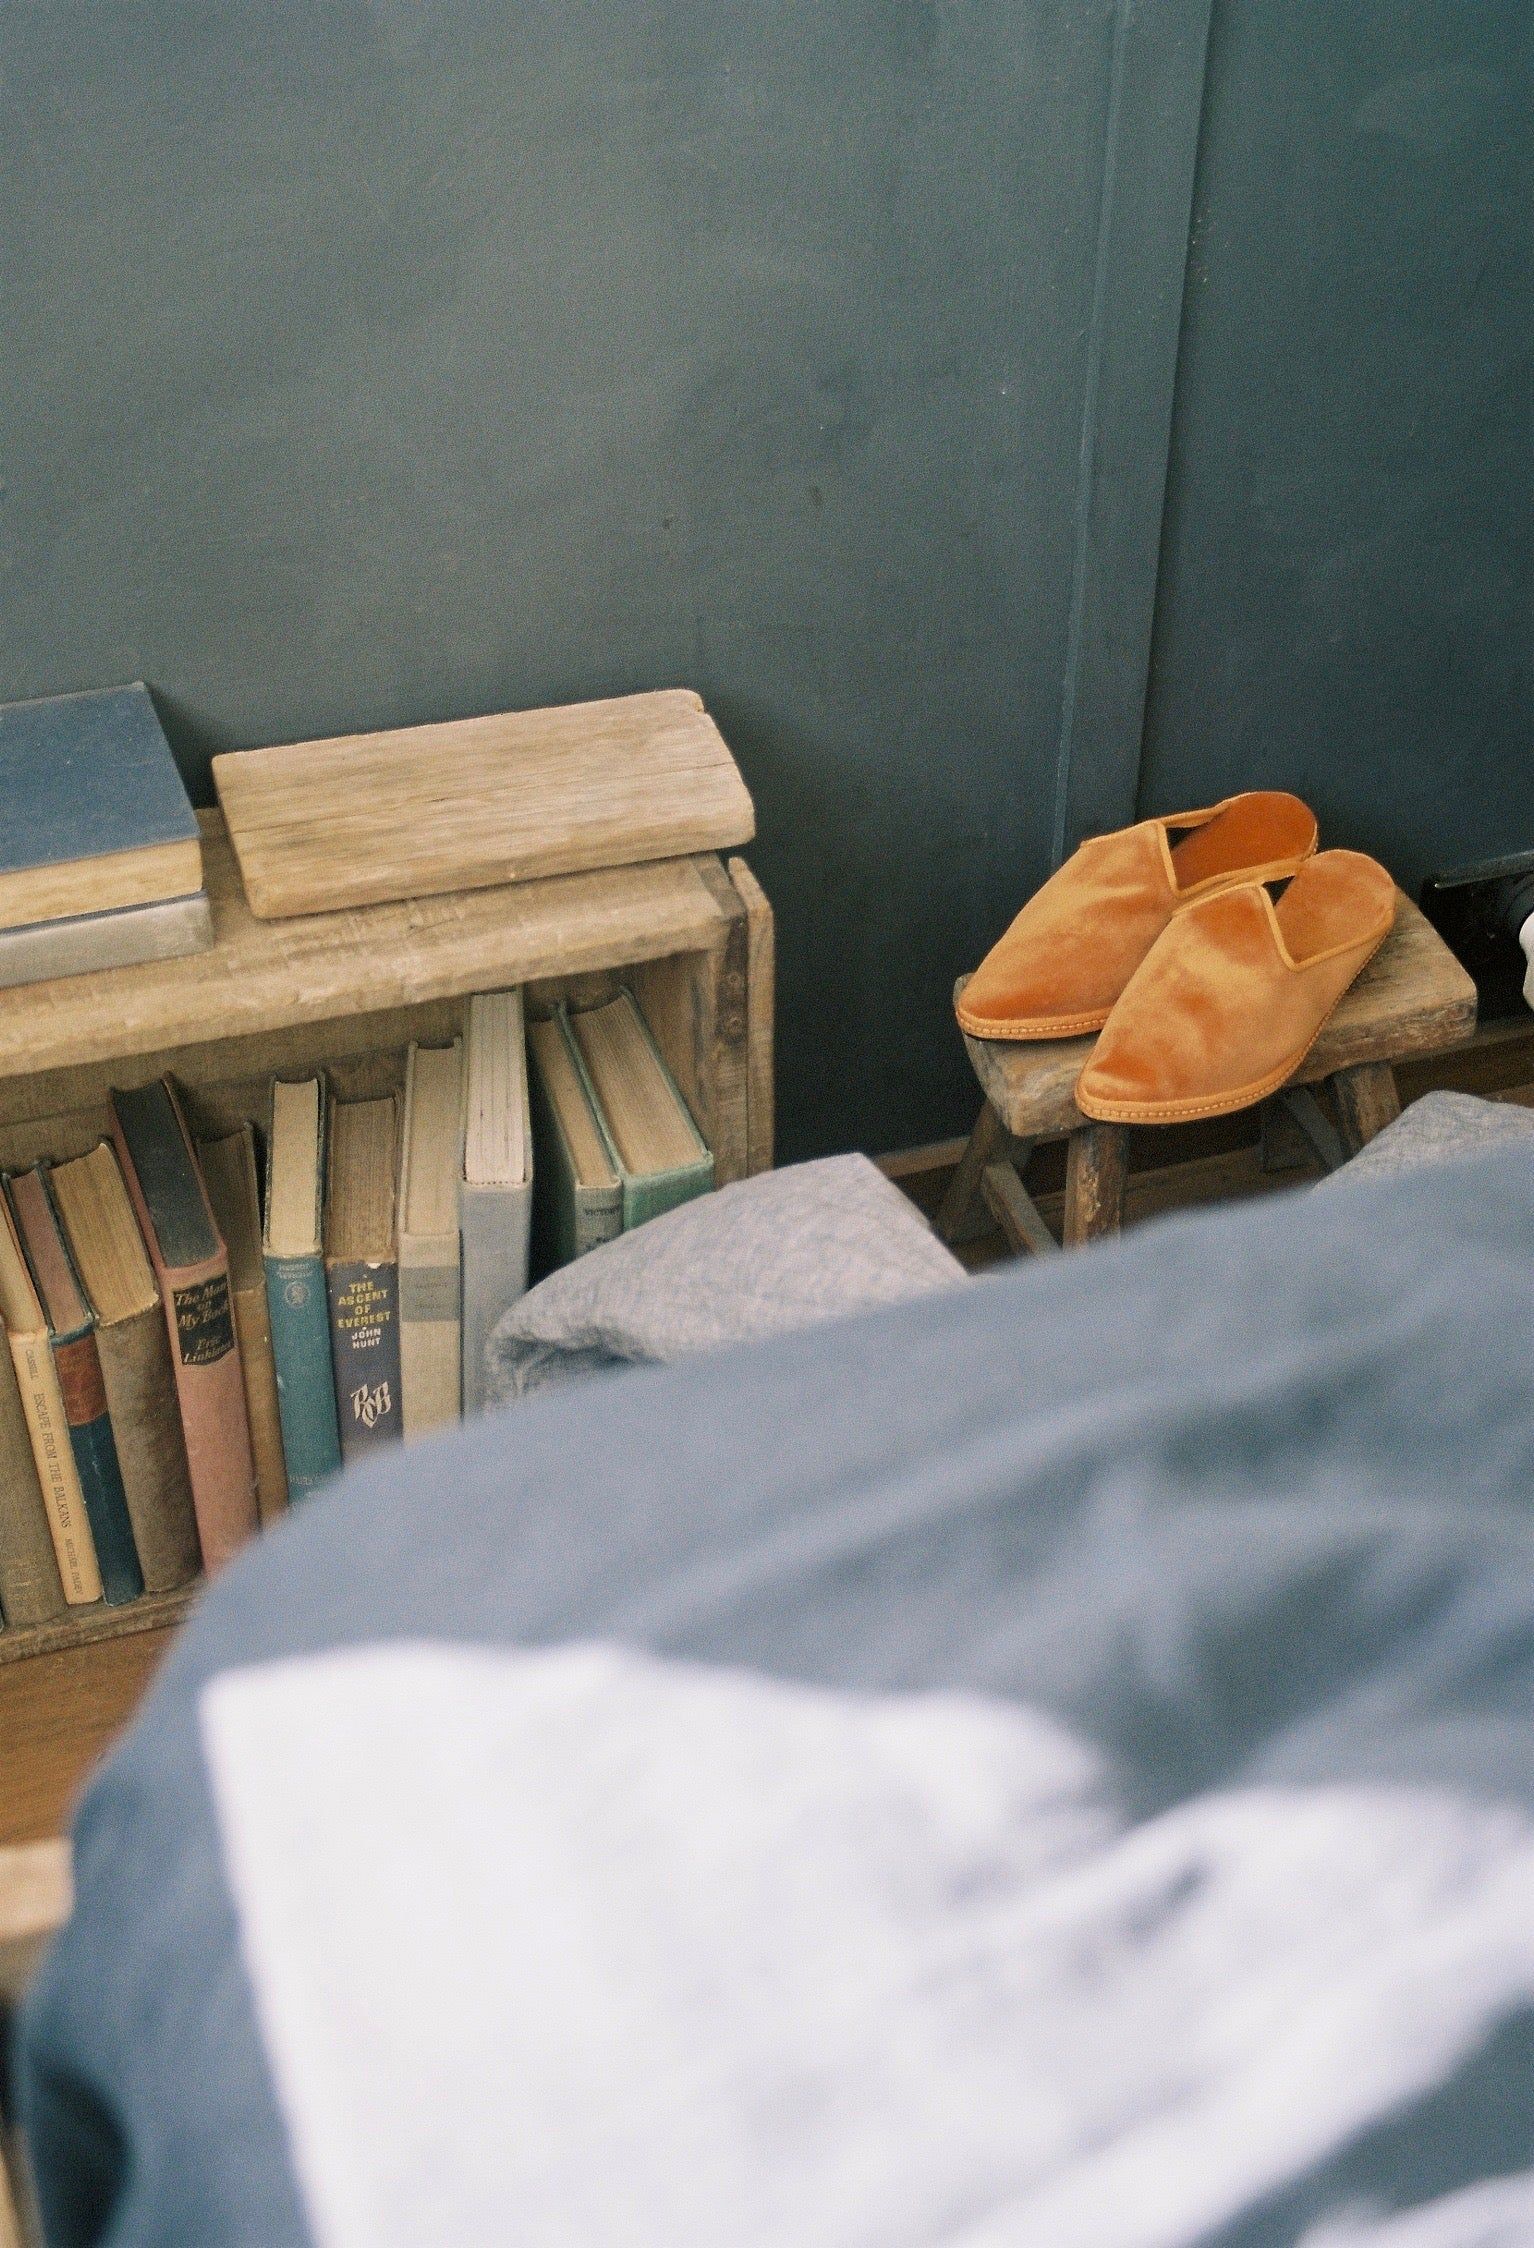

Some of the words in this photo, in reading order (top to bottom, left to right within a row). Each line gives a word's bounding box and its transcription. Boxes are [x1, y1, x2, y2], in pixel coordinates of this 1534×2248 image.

[348, 1281, 374, 1294] THE
[176, 1293, 200, 1306] The
[338, 1289, 388, 1306] ASCENT
[354, 1304, 371, 1315] OF
[179, 1314, 200, 1331] My
[337, 1311, 391, 1328] EVEREST
[351, 1328, 381, 1341] JOHN
[352, 1338, 381, 1349] HUNT
[34, 1393, 52, 1429] ESCAPE
[42, 1431, 58, 1460] FROM
[49, 1462, 63, 1482] THE
[54, 1486, 72, 1529] BALKANS
[65, 1538, 78, 1570] MICHAEL
